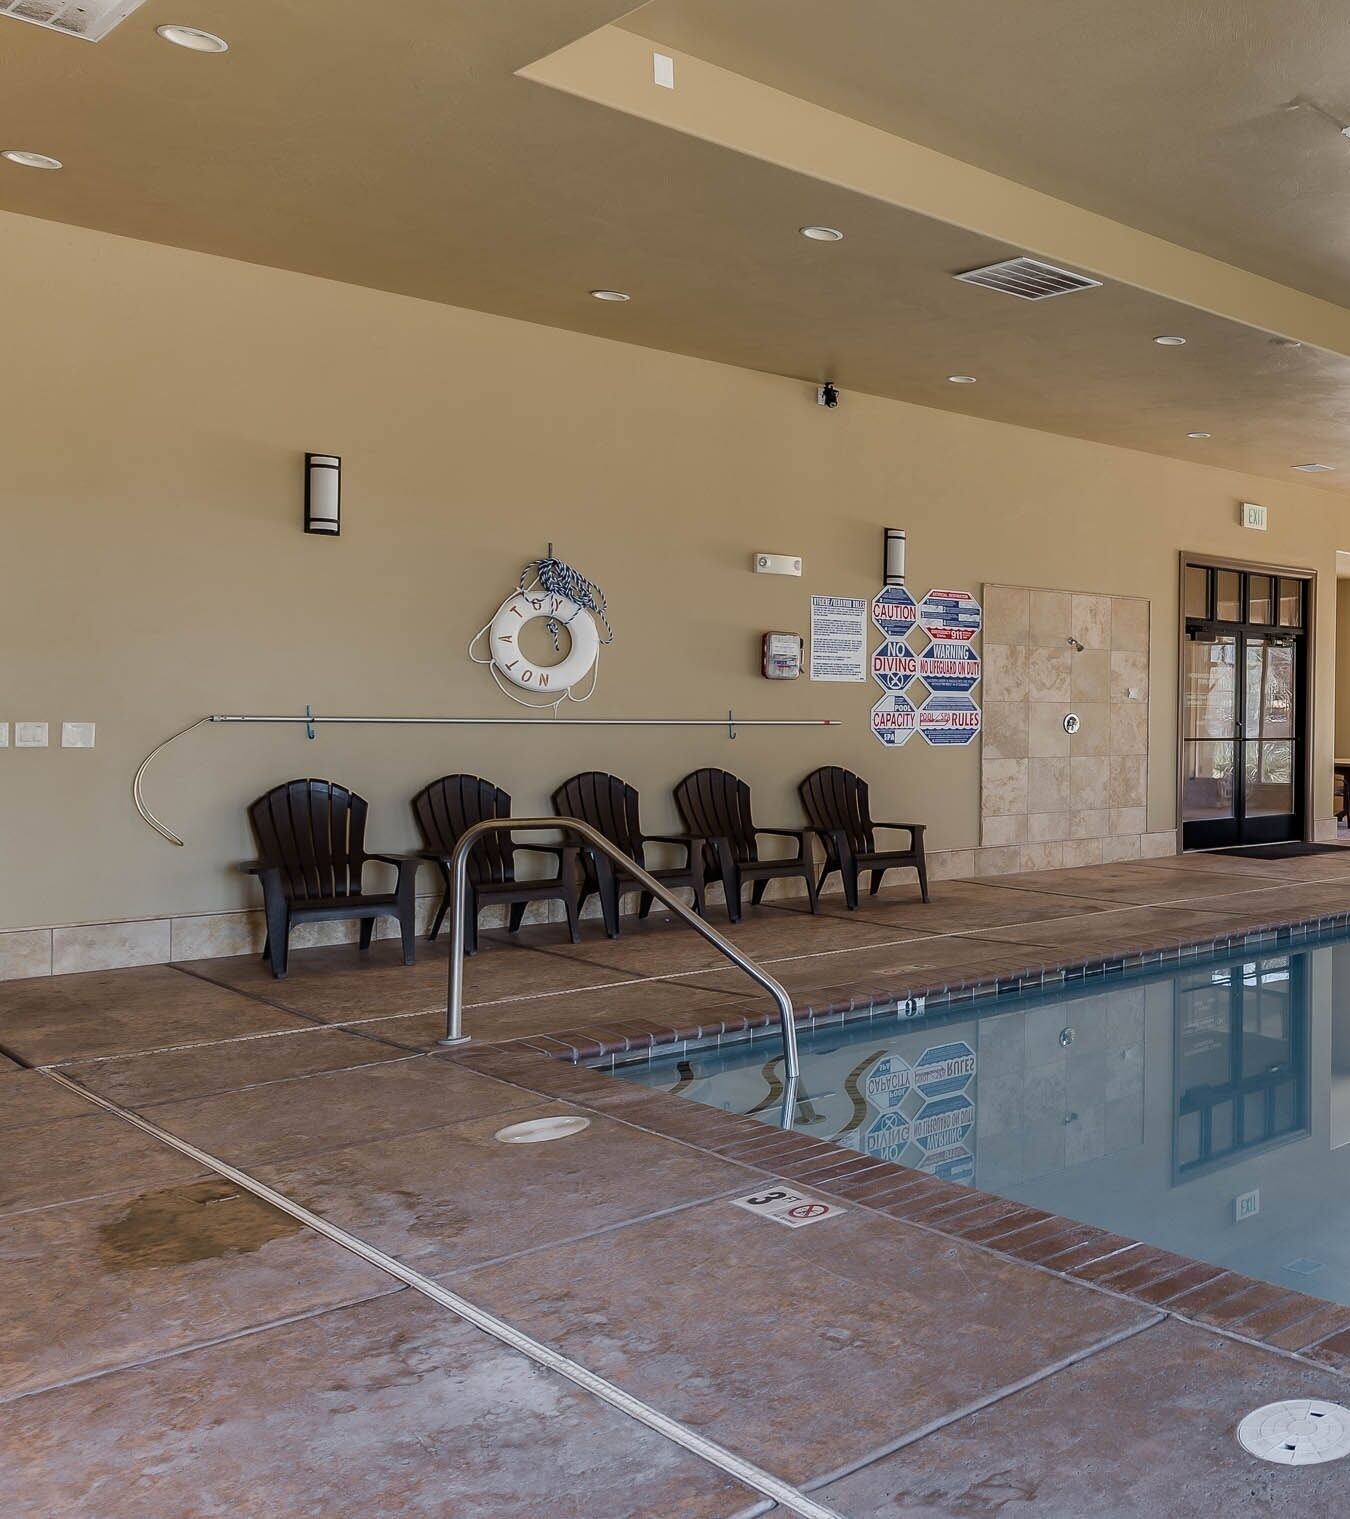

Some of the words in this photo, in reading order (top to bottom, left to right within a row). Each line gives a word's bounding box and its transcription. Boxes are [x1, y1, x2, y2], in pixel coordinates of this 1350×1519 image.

[1248, 508, 1265, 526] EXIT
[508, 598, 564, 618] TOY
[873, 604, 916, 619] CAUTION
[497, 634, 513, 644] A
[951, 630, 963, 640] 911
[887, 642, 905, 657] NO
[933, 644, 969, 660] WARNING
[873, 657, 917, 673] DIVING
[920, 660, 929, 673] NO
[929, 660, 956, 675] LIFEGUARD
[958, 661, 966, 675] ON
[967, 661, 981, 676] DUTY
[505, 659, 549, 687] NOT
[894, 704, 912, 712] POOL
[873, 712, 916, 727] CAPACITY
[951, 712, 979, 726] RULES
[884, 733, 895, 741] SPA
[746, 1191, 787, 1205] 3
